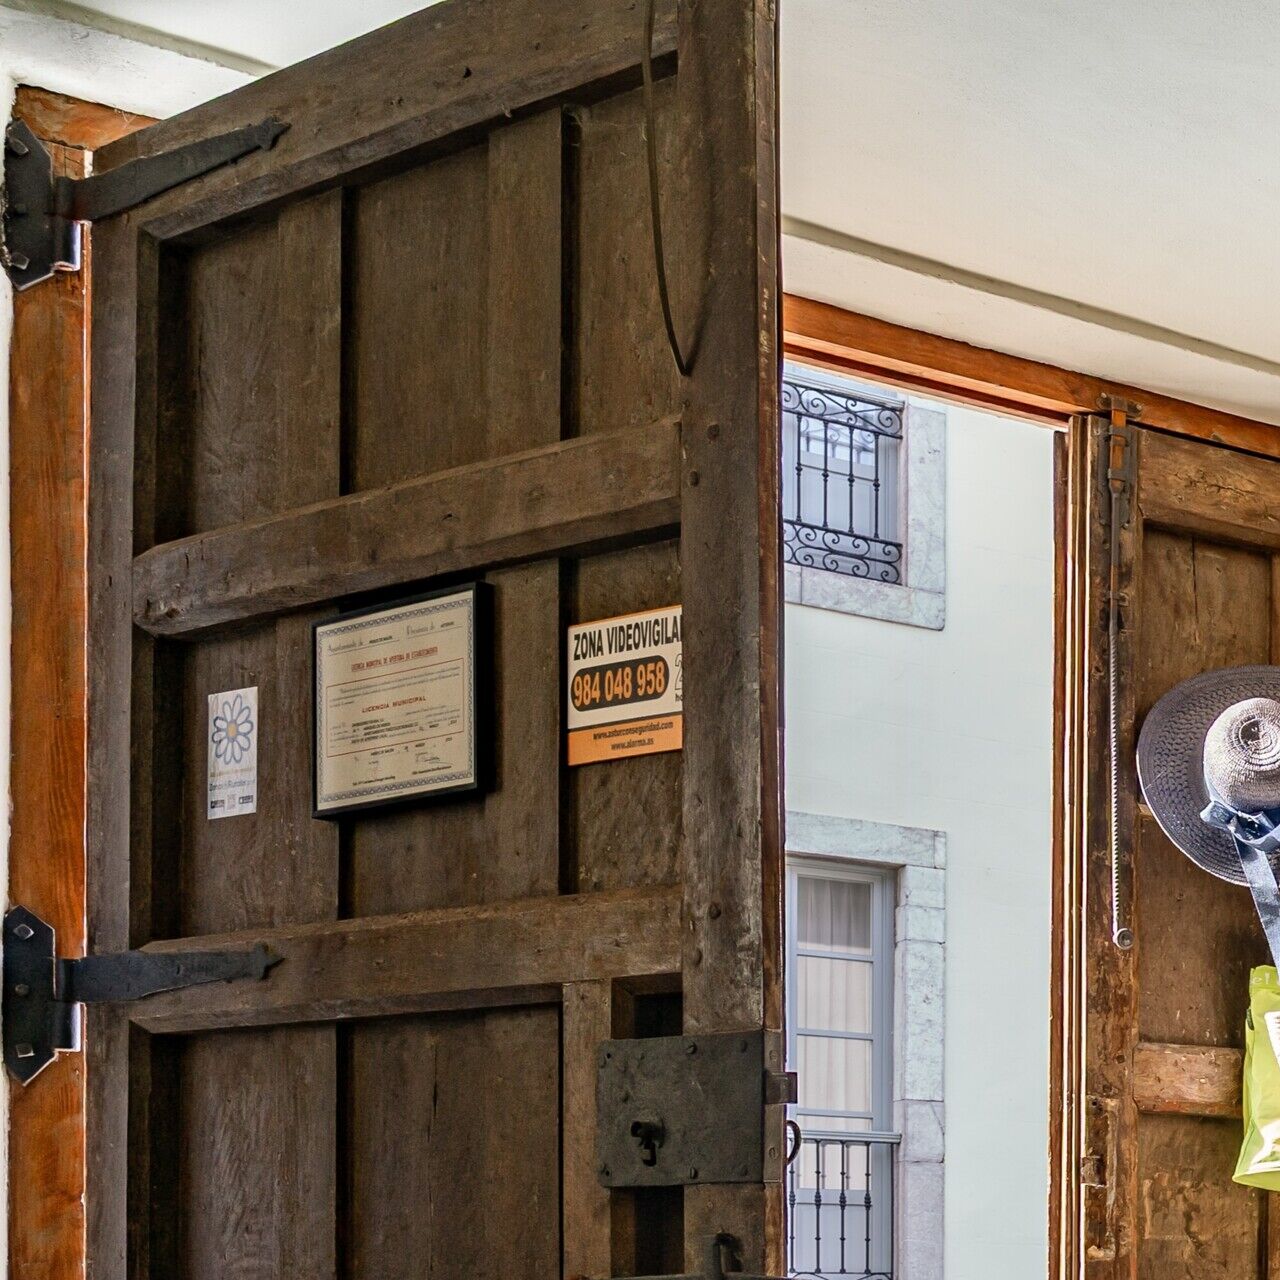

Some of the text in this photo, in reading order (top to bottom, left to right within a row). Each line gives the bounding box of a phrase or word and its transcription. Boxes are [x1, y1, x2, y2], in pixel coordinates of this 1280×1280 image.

[574, 614, 683, 661] ZONA VIDEOVIGILA
[573, 660, 666, 708] 984 048 958
